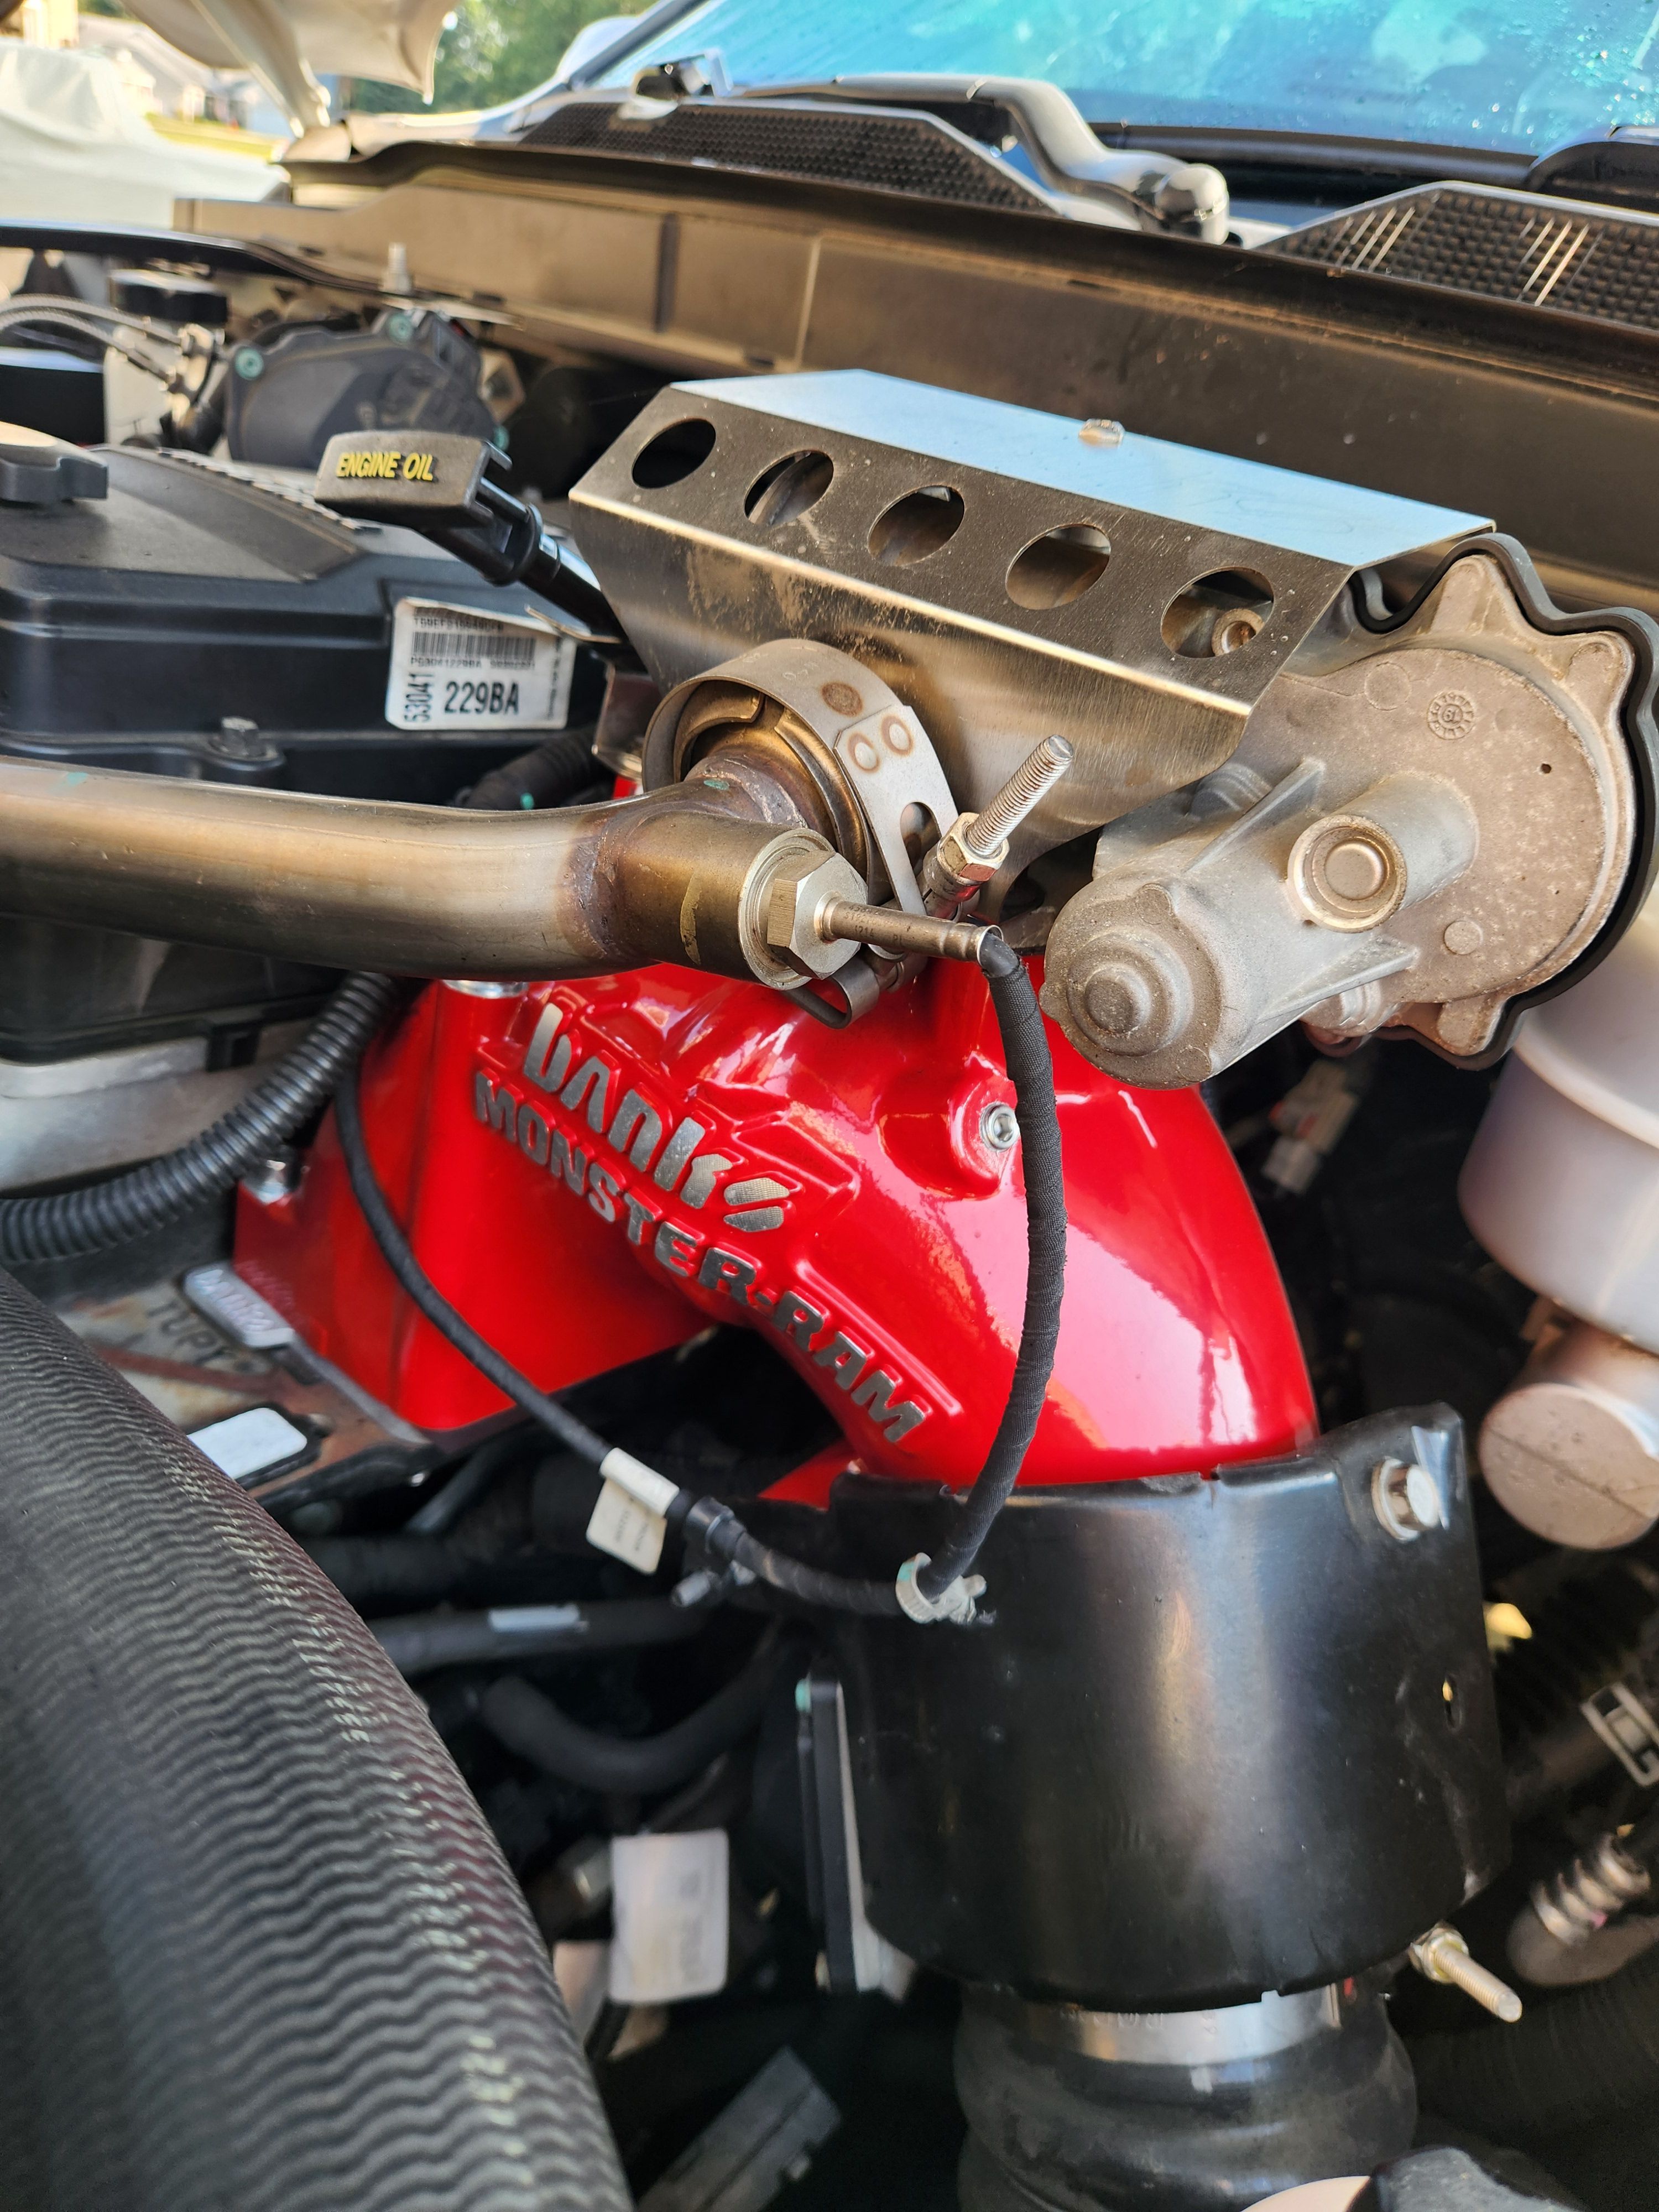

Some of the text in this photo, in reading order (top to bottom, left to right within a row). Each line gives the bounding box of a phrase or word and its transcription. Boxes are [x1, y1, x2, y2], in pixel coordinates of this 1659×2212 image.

[336, 451, 433, 481] ENGINE OIL
[445, 681, 519, 714] 229BA
